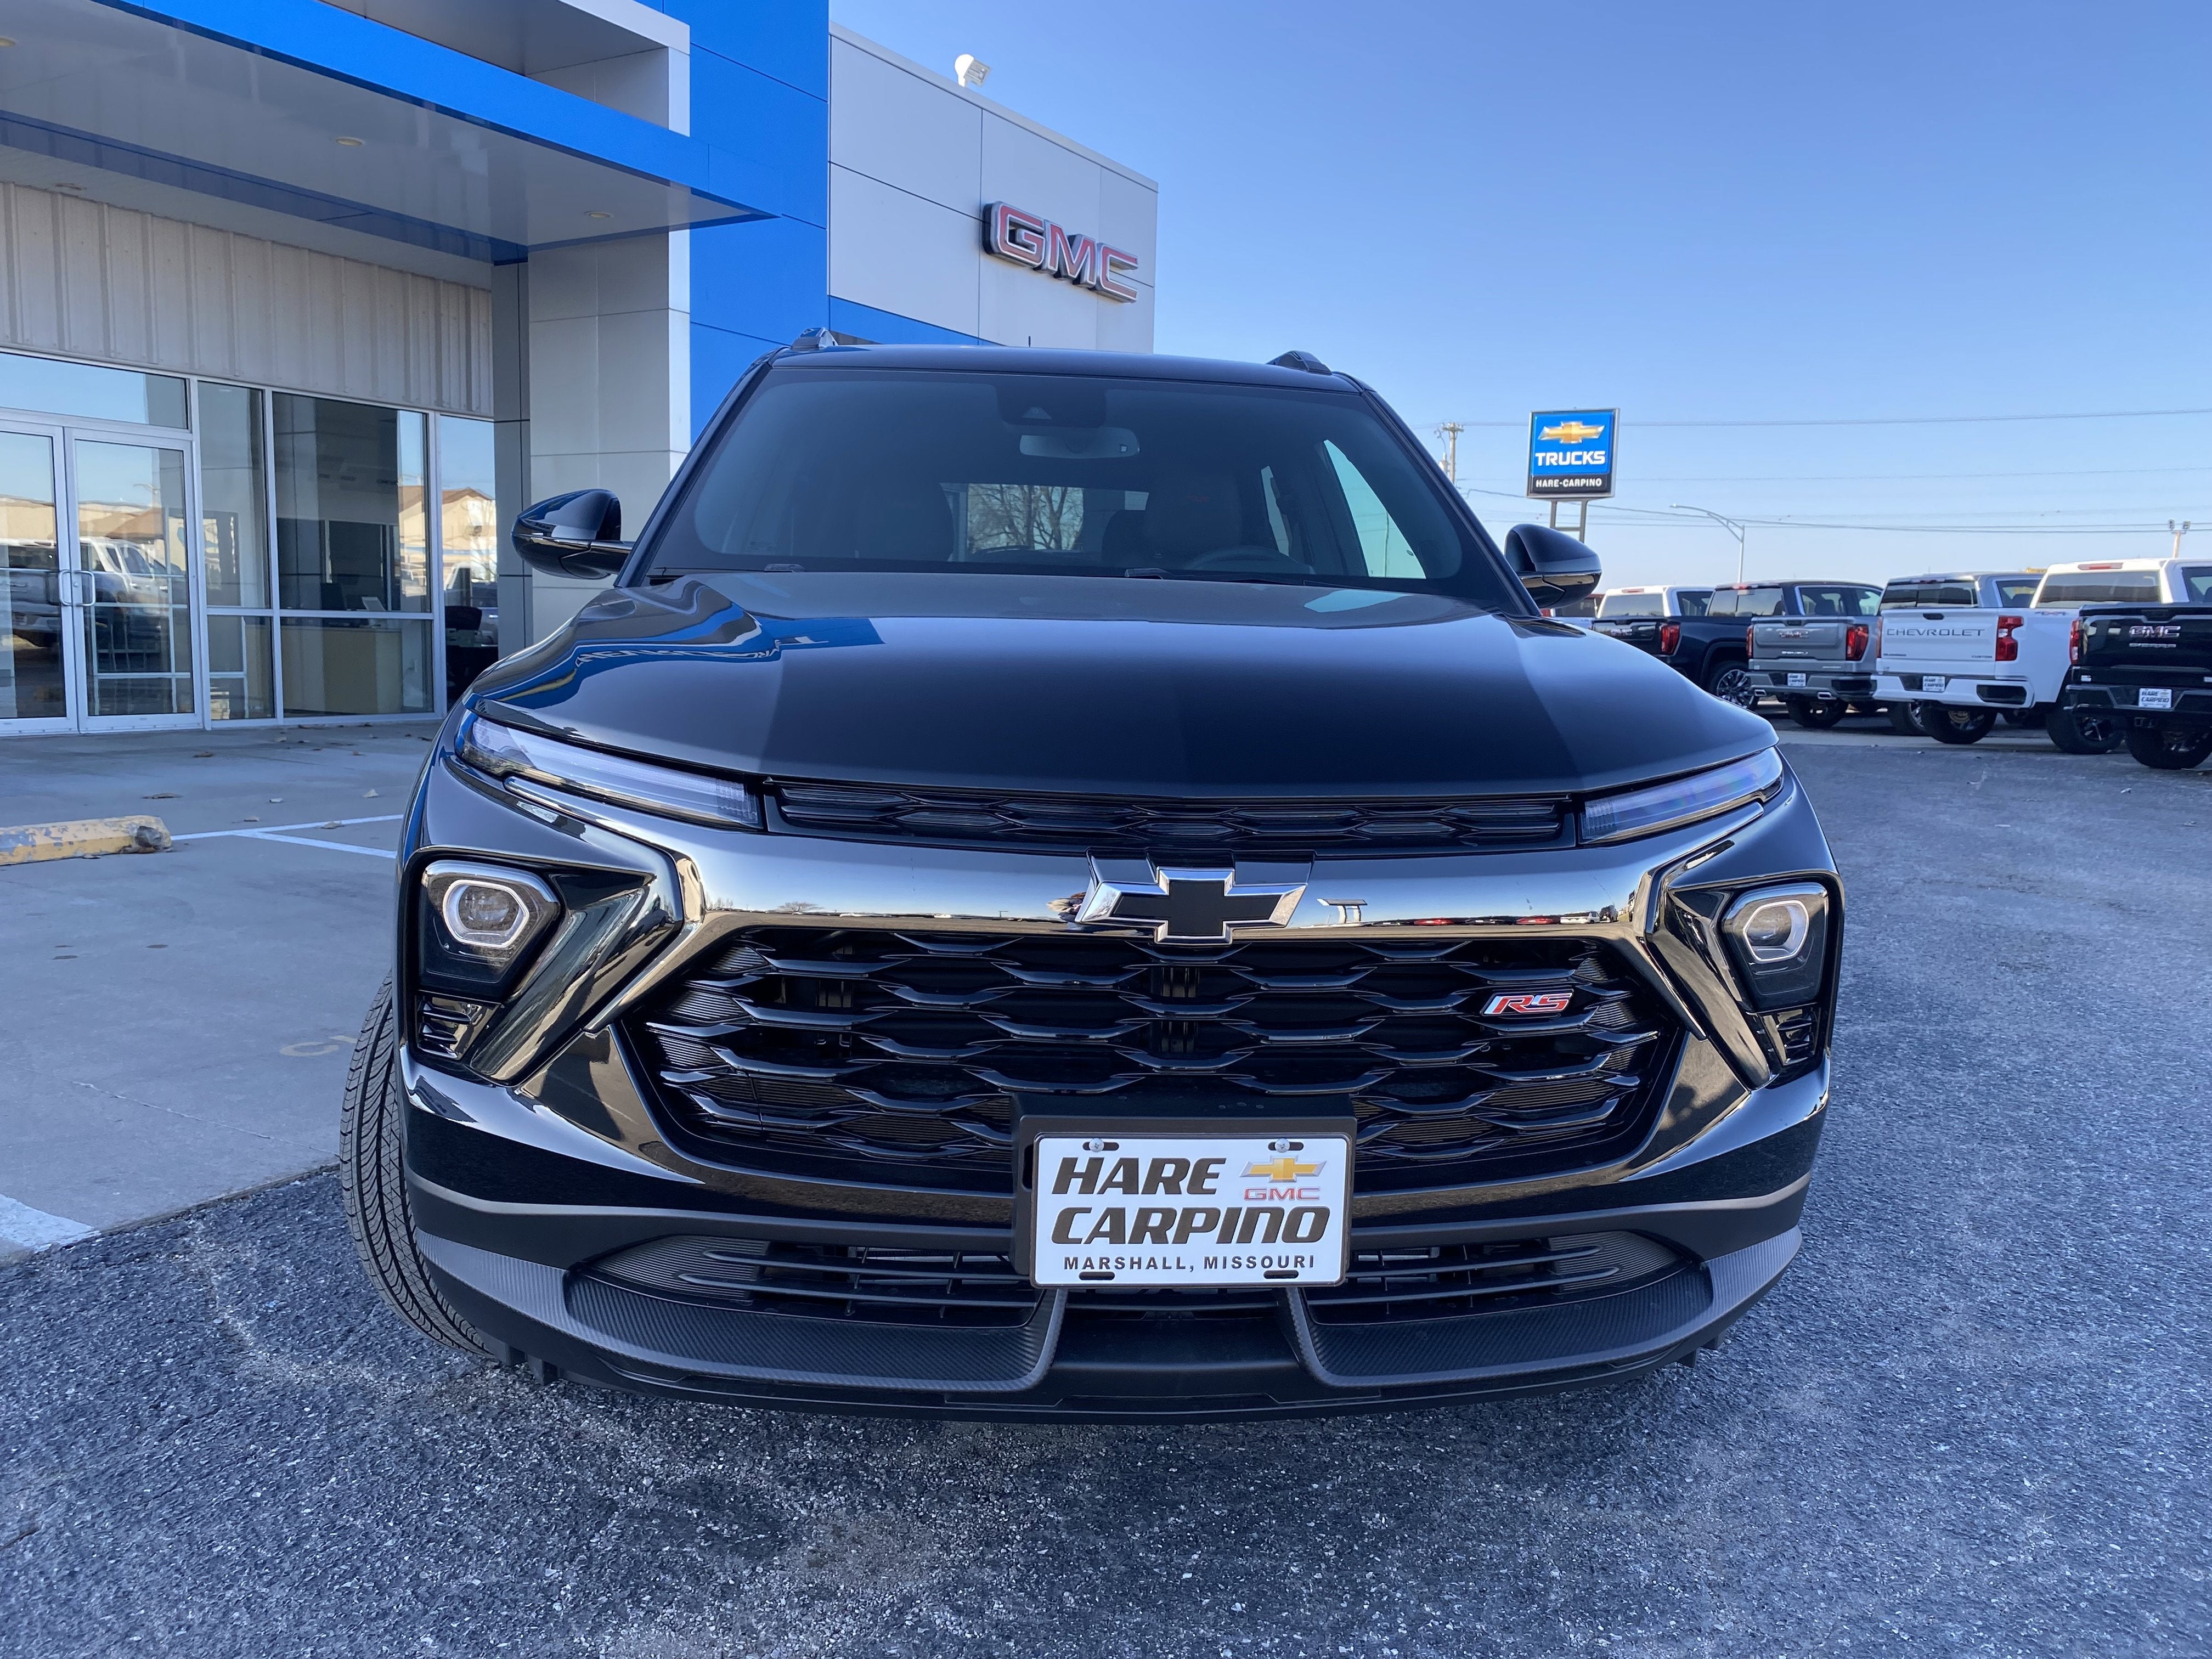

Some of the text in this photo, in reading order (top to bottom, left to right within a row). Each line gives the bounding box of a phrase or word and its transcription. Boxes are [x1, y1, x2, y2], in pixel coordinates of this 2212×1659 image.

[989, 201, 1138, 302] GMC
[1535, 450, 1606, 466] TRUCKS
[1535, 478, 1602, 488] HARE-CARPINO
[2129, 625, 2181, 638] GMC
[1483, 992, 1573, 1014] RS
[1051, 1156, 1227, 1195] HARE
[1243, 1186, 1321, 1201] GMC
[1051, 1206, 1331, 1245] CARPINO
[1063, 1254, 1314, 1273] MARSHALL, MISSOURI
